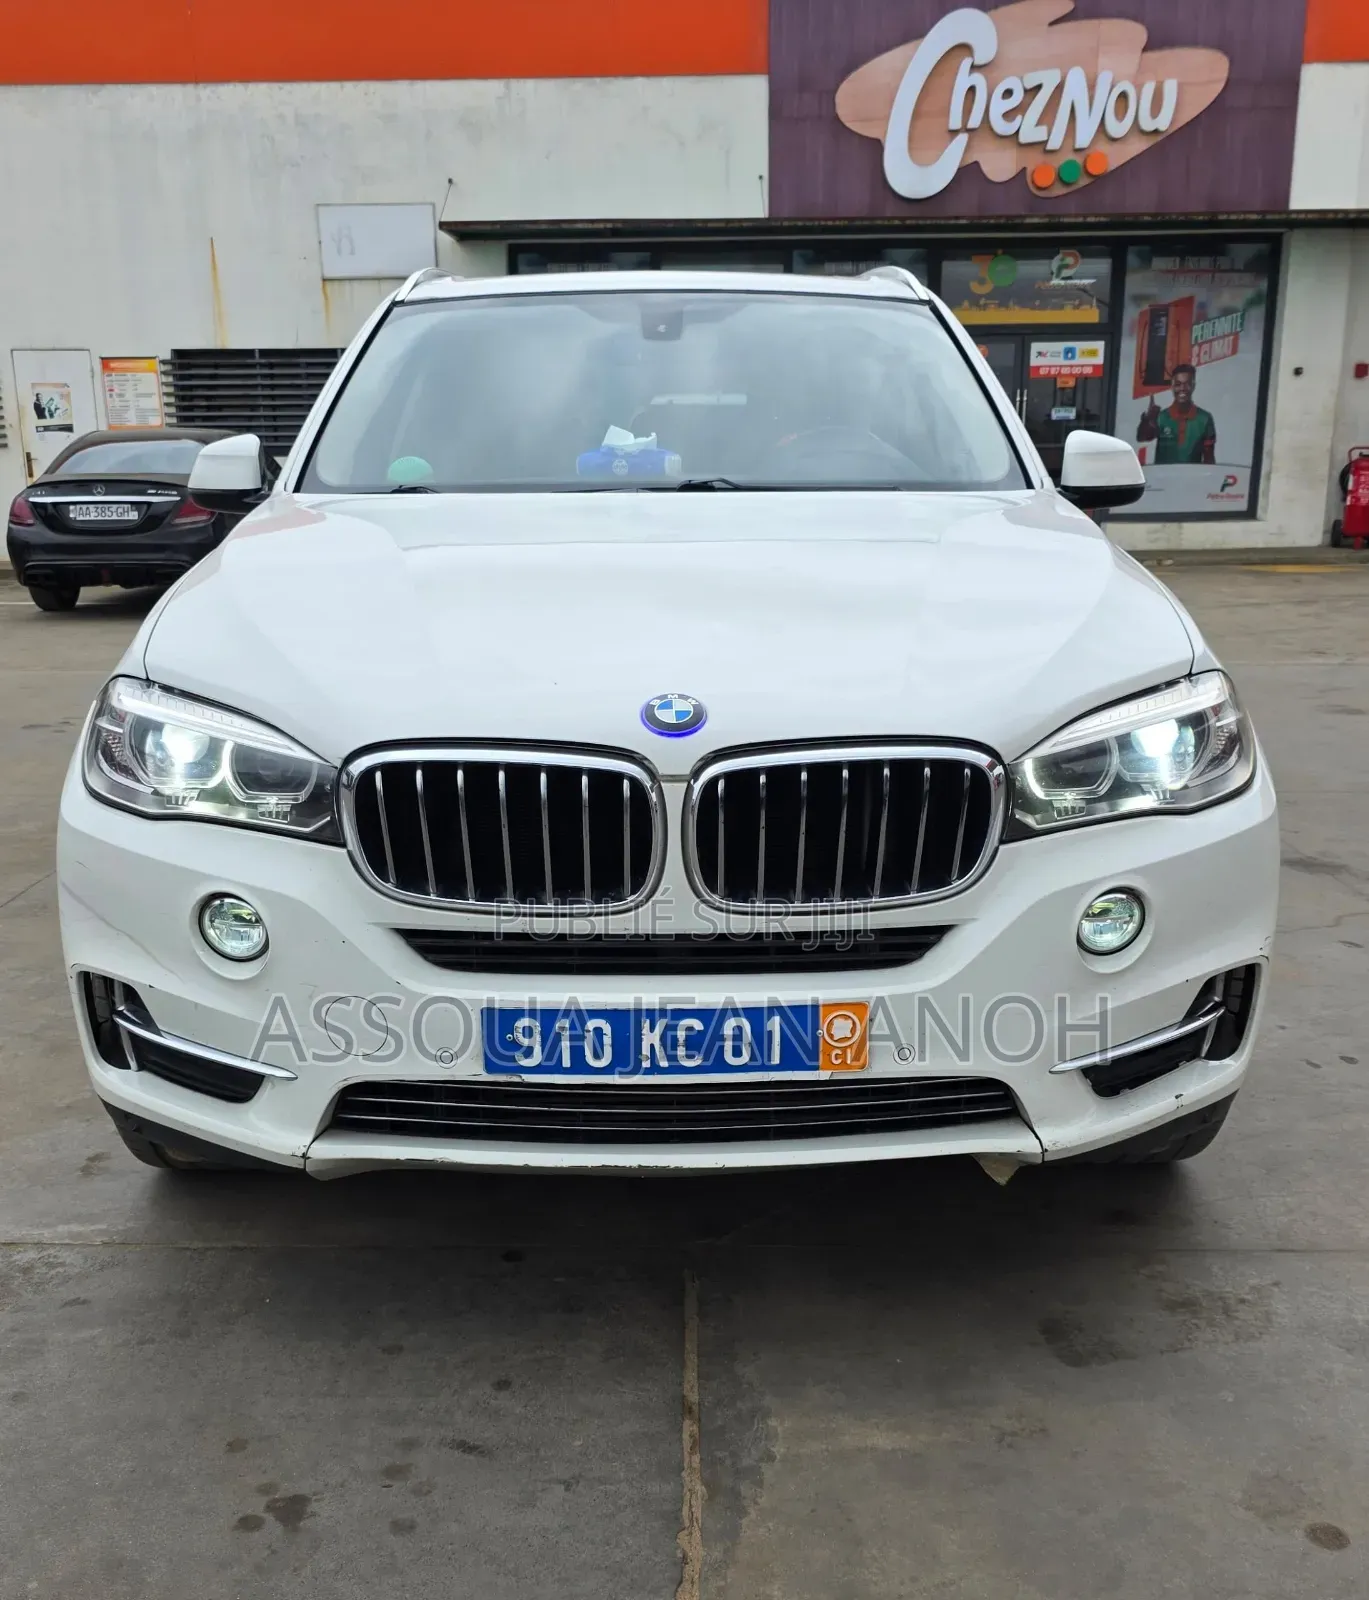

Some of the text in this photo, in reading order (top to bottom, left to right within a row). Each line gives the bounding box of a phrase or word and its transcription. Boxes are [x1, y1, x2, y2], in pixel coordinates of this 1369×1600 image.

[649, 694, 699, 706] BMW
[513, 1016, 781, 1068] 910 KC 01
[830, 1050, 853, 1065] CI
